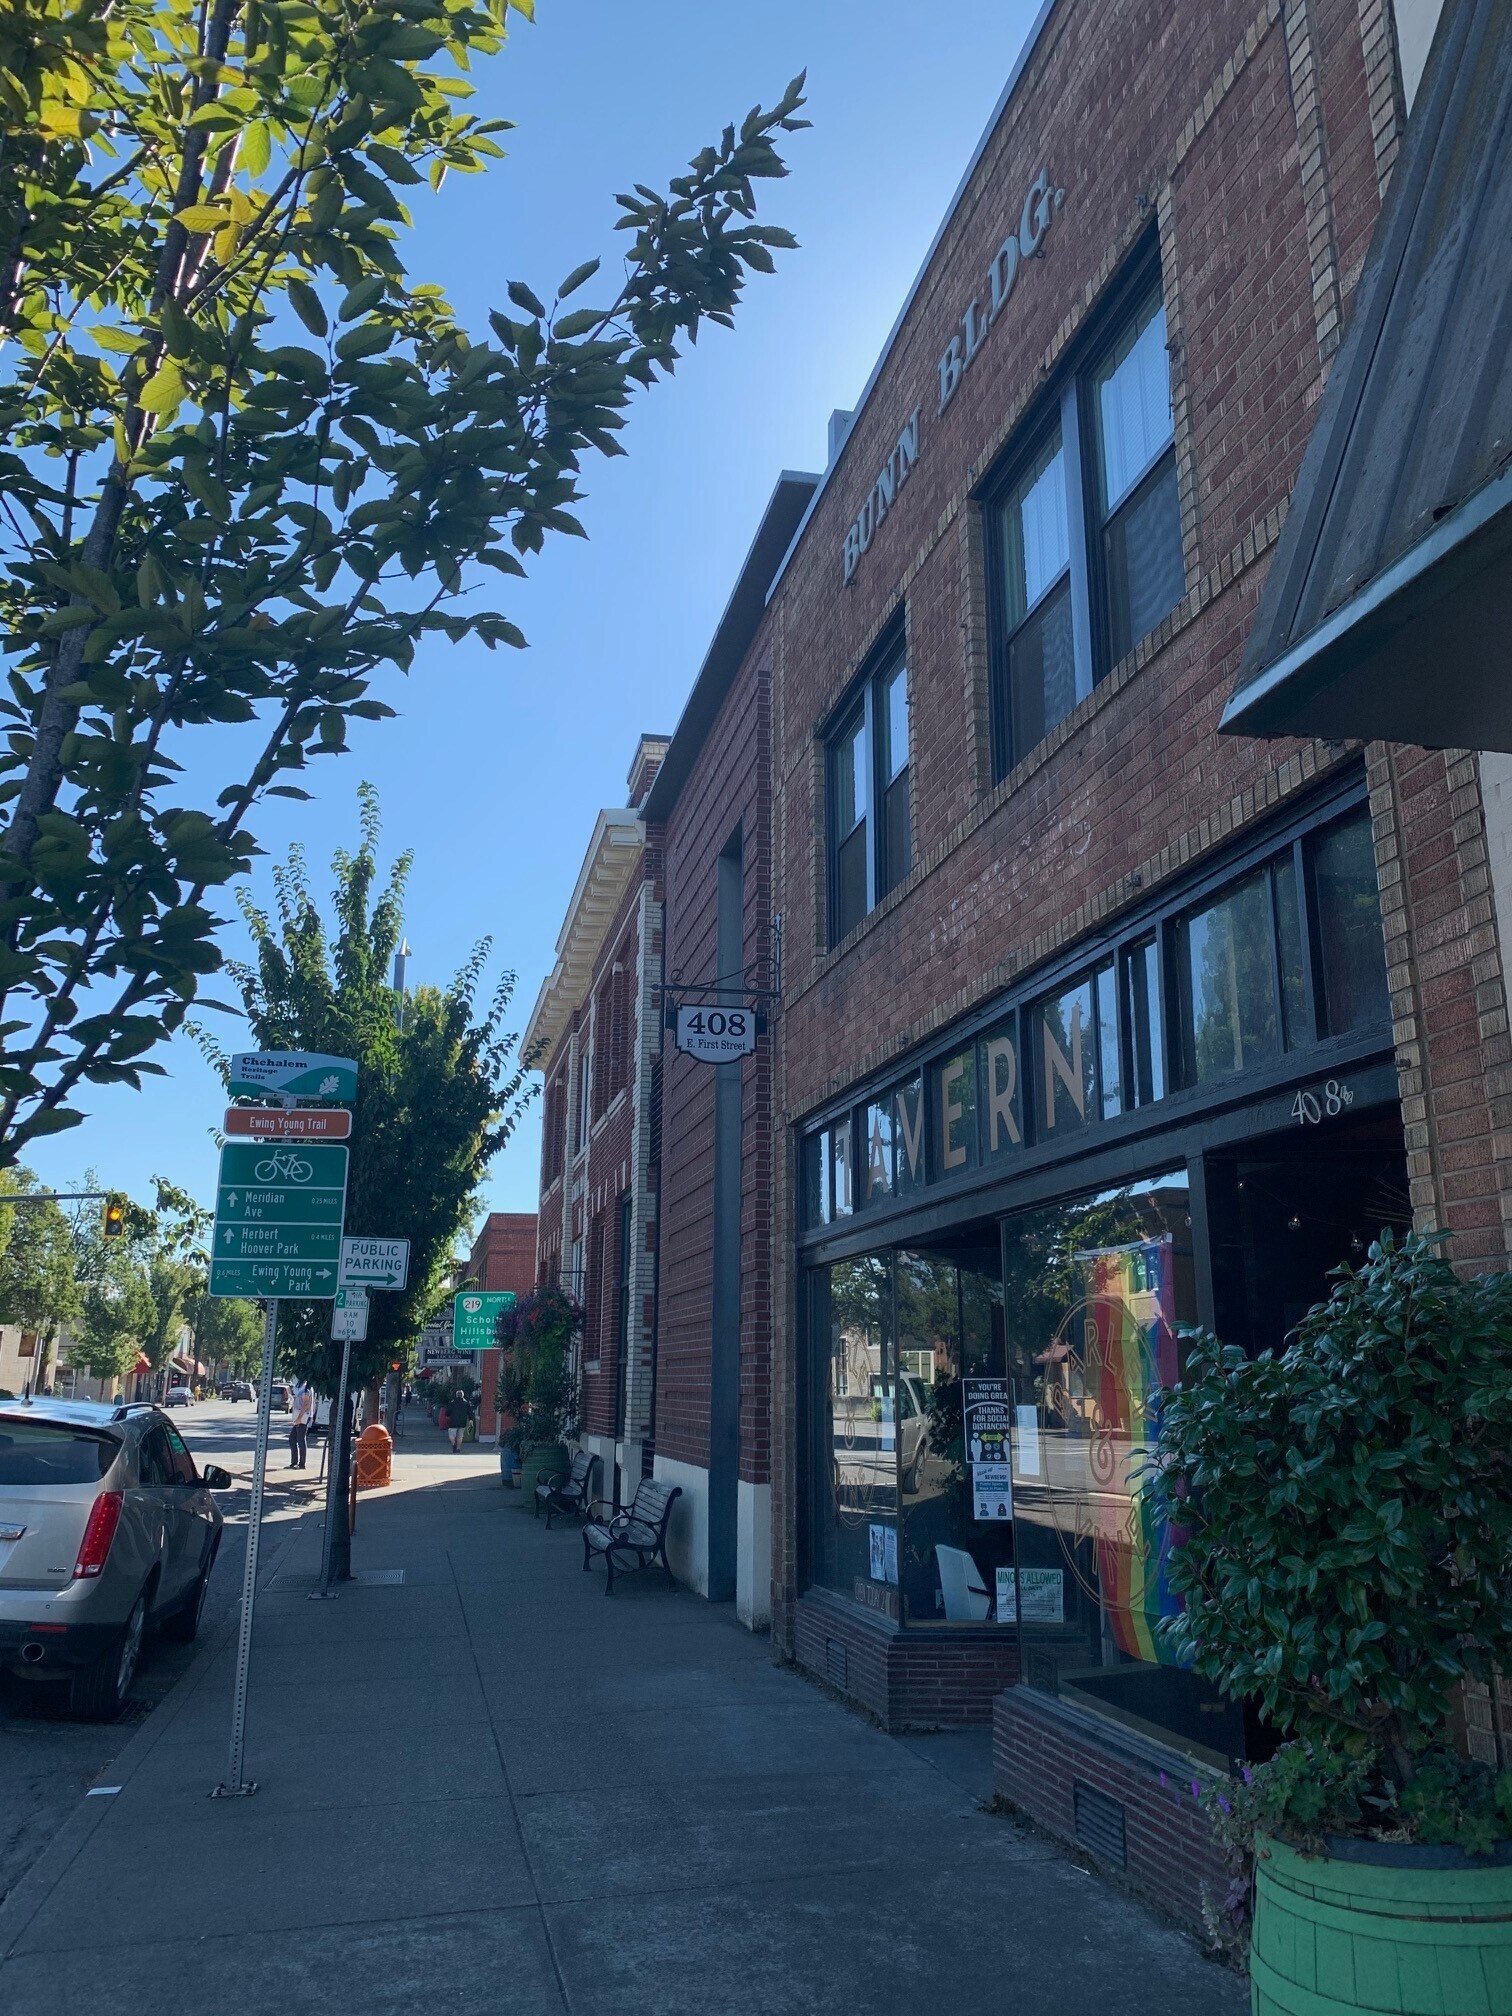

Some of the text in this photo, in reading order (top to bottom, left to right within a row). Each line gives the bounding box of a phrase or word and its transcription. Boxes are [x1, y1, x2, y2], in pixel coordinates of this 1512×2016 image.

[842, 402, 923, 589] BUNN
[687, 1012, 746, 1036] 408
[687, 1038, 746, 1051] E. First Street
[242, 1057, 308, 1068] Chehalem
[241, 1066, 278, 1074] Heritage
[835, 1004, 1085, 1206] TAVERN
[250, 1116, 327, 1132] Ewing Young Trail
[245, 1191, 285, 1203] Meridian
[244, 1206, 262, 1217] Ave
[242, 1228, 279, 1240] Herbert
[240, 1242, 299, 1254] Hoover Park
[351, 1243, 399, 1256] PUBLIC
[345, 1258, 402, 1271] PARKING
[252, 1265, 312, 1280] Ewing Young
[288, 1280, 310, 1291] Park
[337, 1292, 344, 1305] 2
[464, 1300, 480, 1309] 219
[466, 1316, 502, 1324] Schol
[978, 1383, 1002, 1391] YOU'RE
[968, 1392, 1008, 1400] DOING GREA
[1089, 1403, 1116, 1486] &
[997, 1571, 1062, 1585] MINOS ALLOWED
